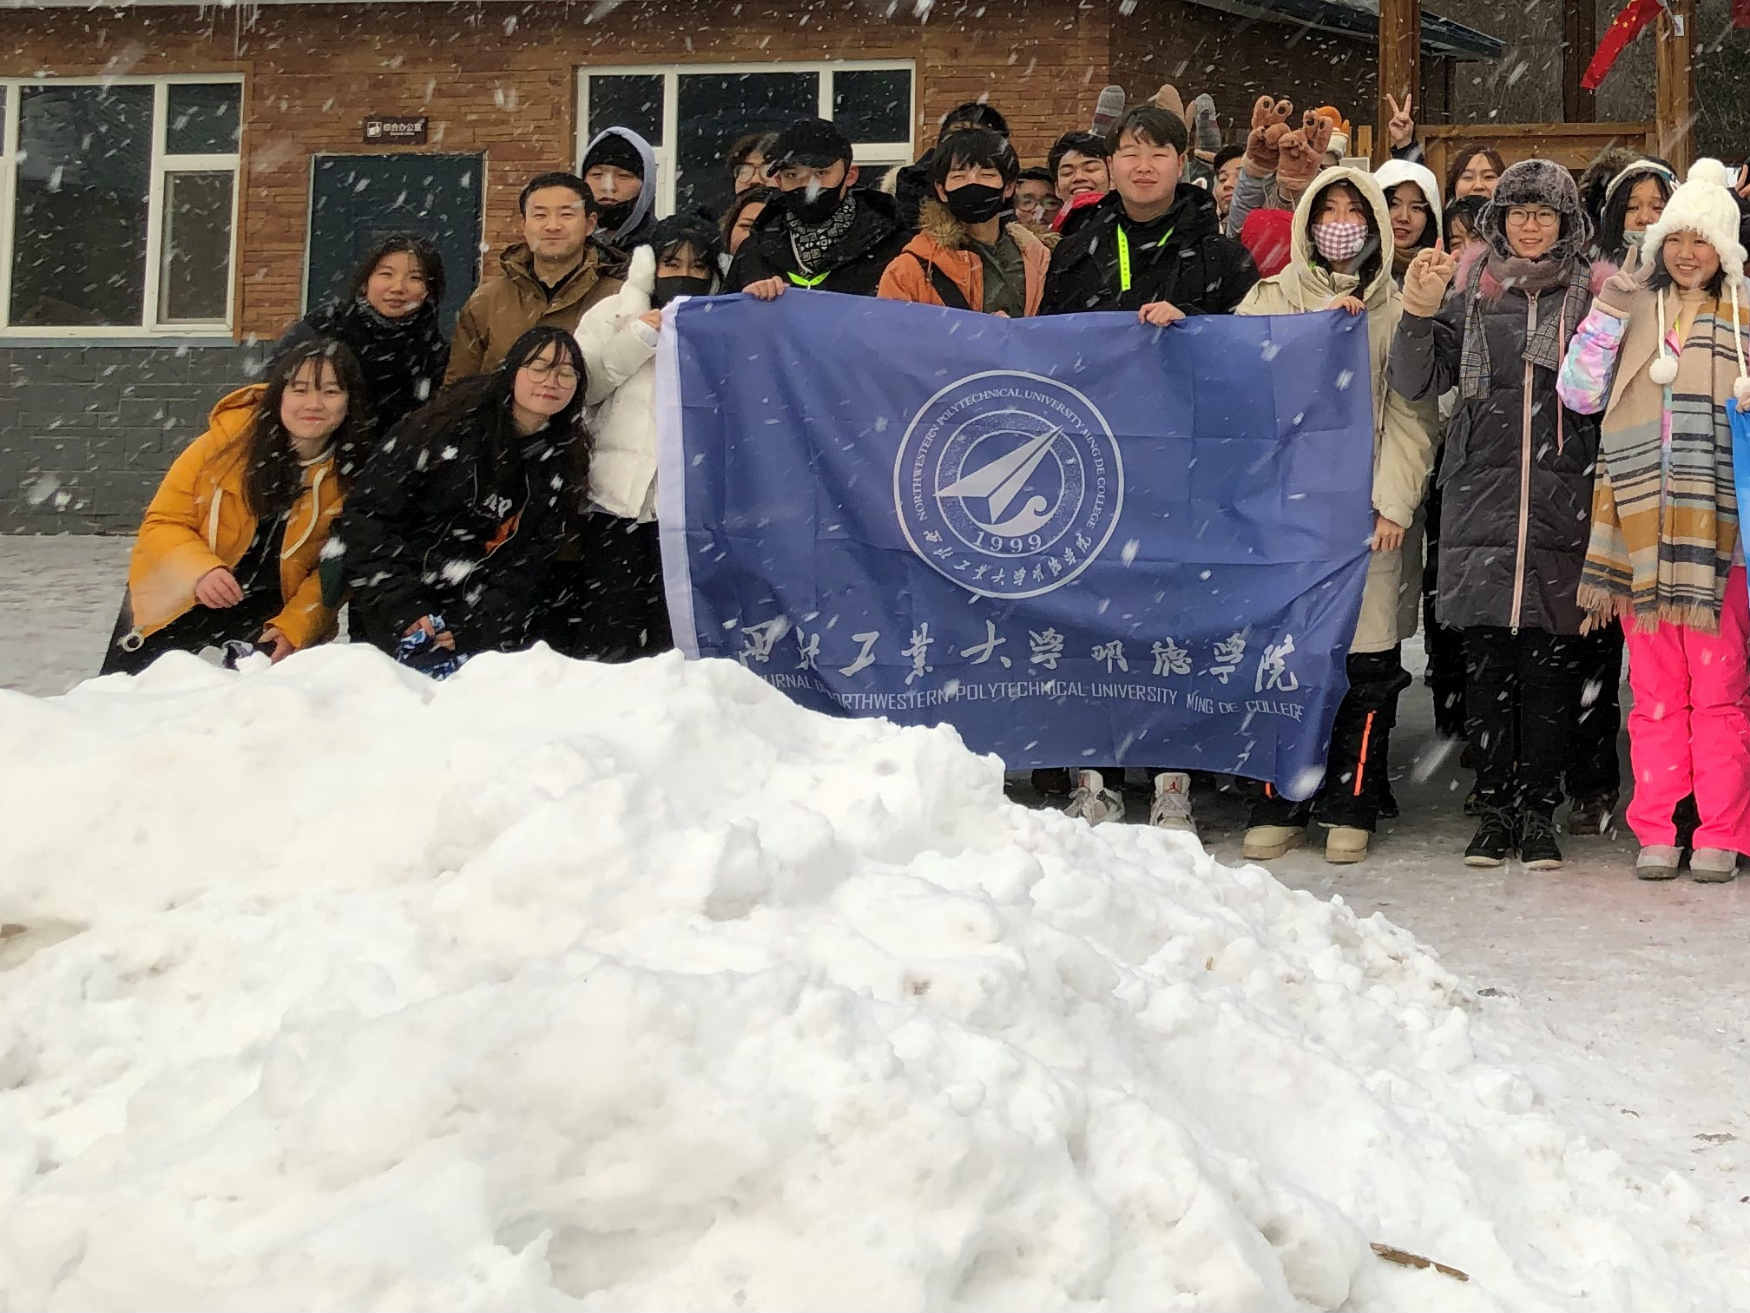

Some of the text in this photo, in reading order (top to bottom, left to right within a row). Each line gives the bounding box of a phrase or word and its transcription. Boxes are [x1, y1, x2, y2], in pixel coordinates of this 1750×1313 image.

[912, 388, 1107, 529] NORTHWESTERN POLYTECHNICAL UNIVERSITY MING DE COLLEGE
[972, 530, 1042, 554] 1999
[956, 681, 1089, 701] POLYTECHNICAL
[1091, 683, 1178, 705] UNIVERSITY
[1186, 693, 1214, 714] MING
[1219, 701, 1241, 714] DE
[1246, 700, 1305, 723] COLLEGE
